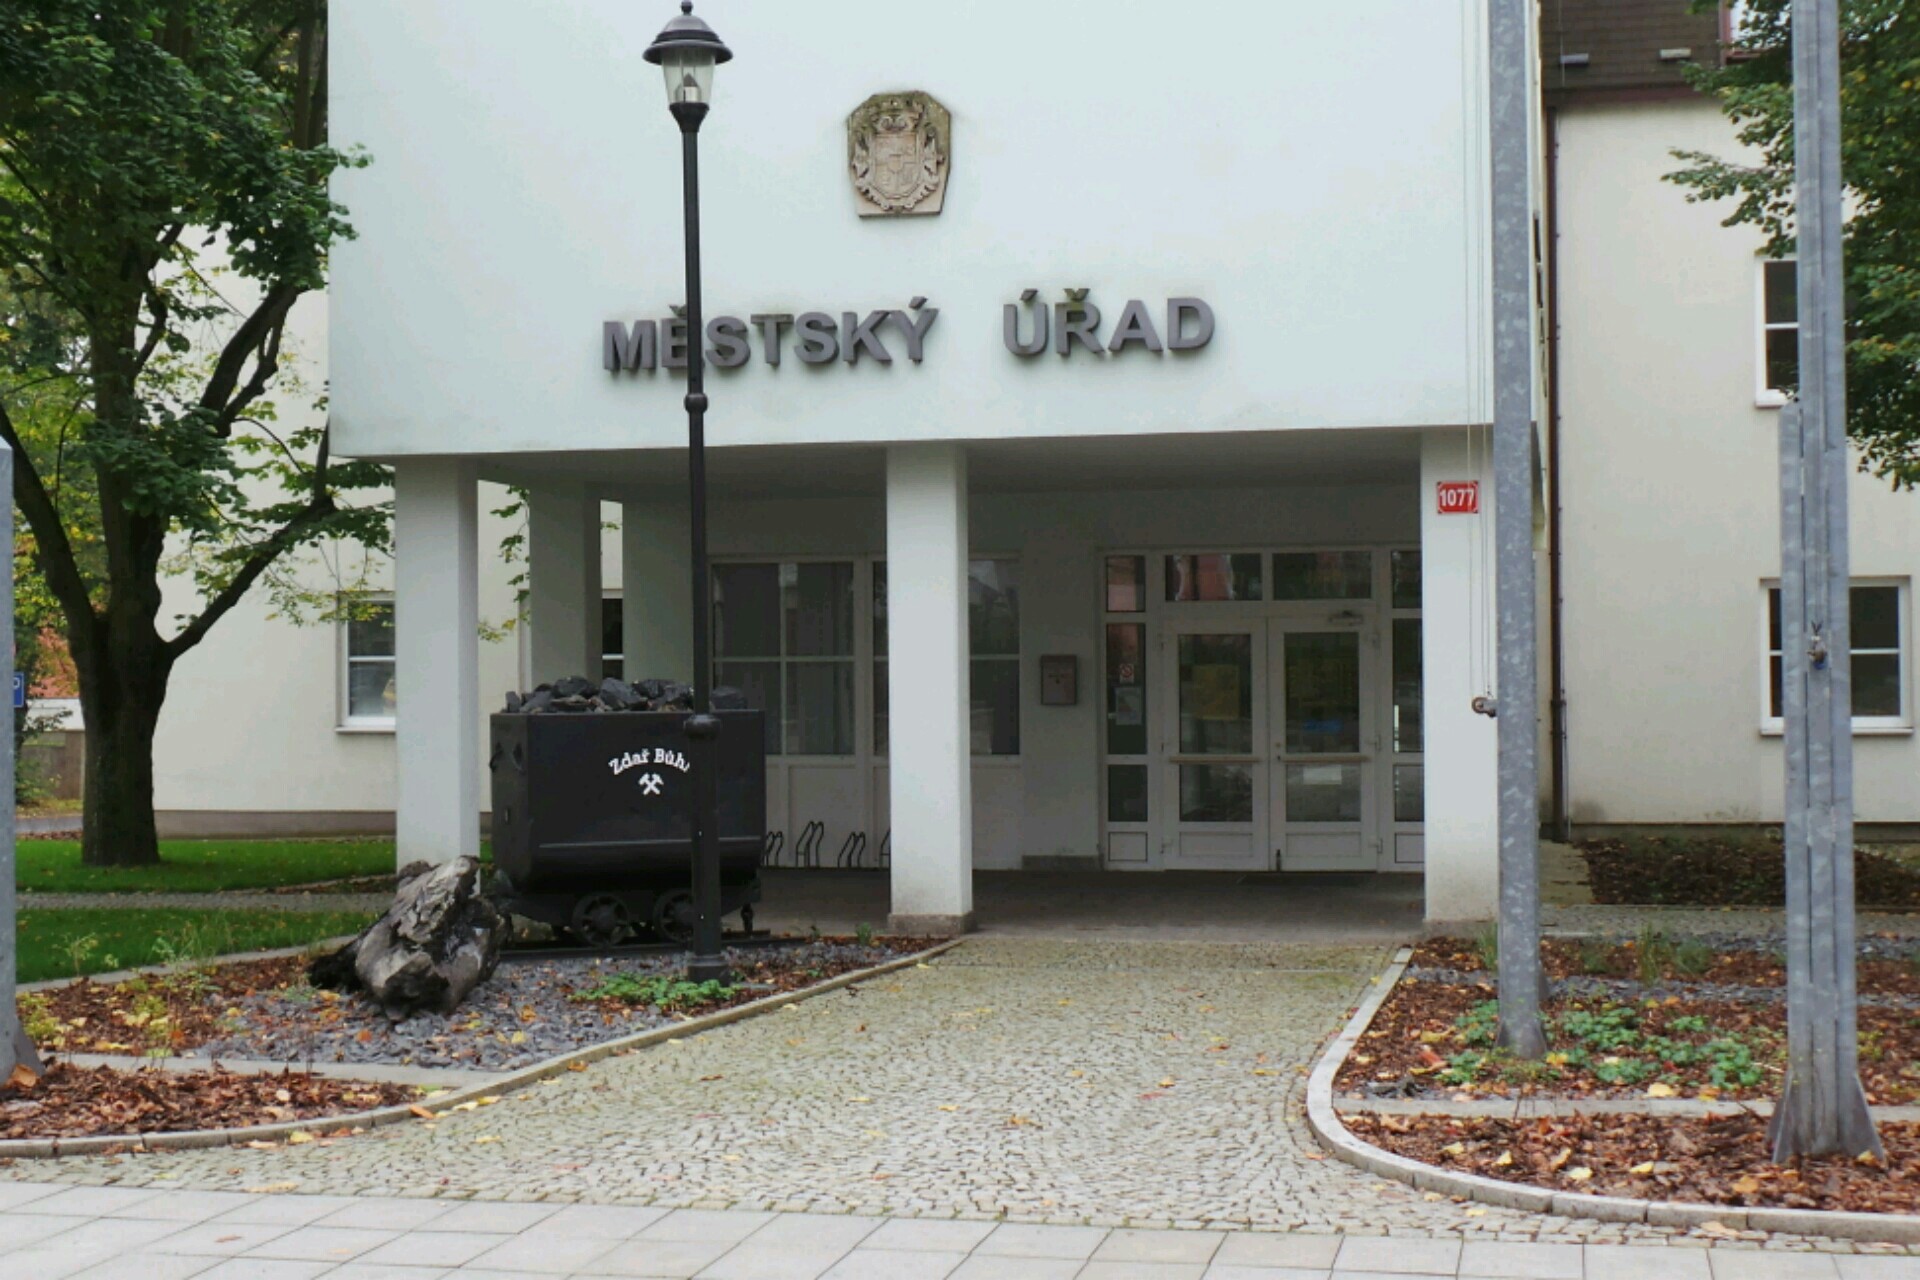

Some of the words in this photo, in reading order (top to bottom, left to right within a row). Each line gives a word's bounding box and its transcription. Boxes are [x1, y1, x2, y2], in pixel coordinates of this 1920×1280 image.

[603, 296, 939, 371] MĚSTSKÝ
[1003, 288, 1215, 356] ÚŘAD
[1440, 489, 1474, 506] 1077
[608, 748, 649, 775] Zdař
